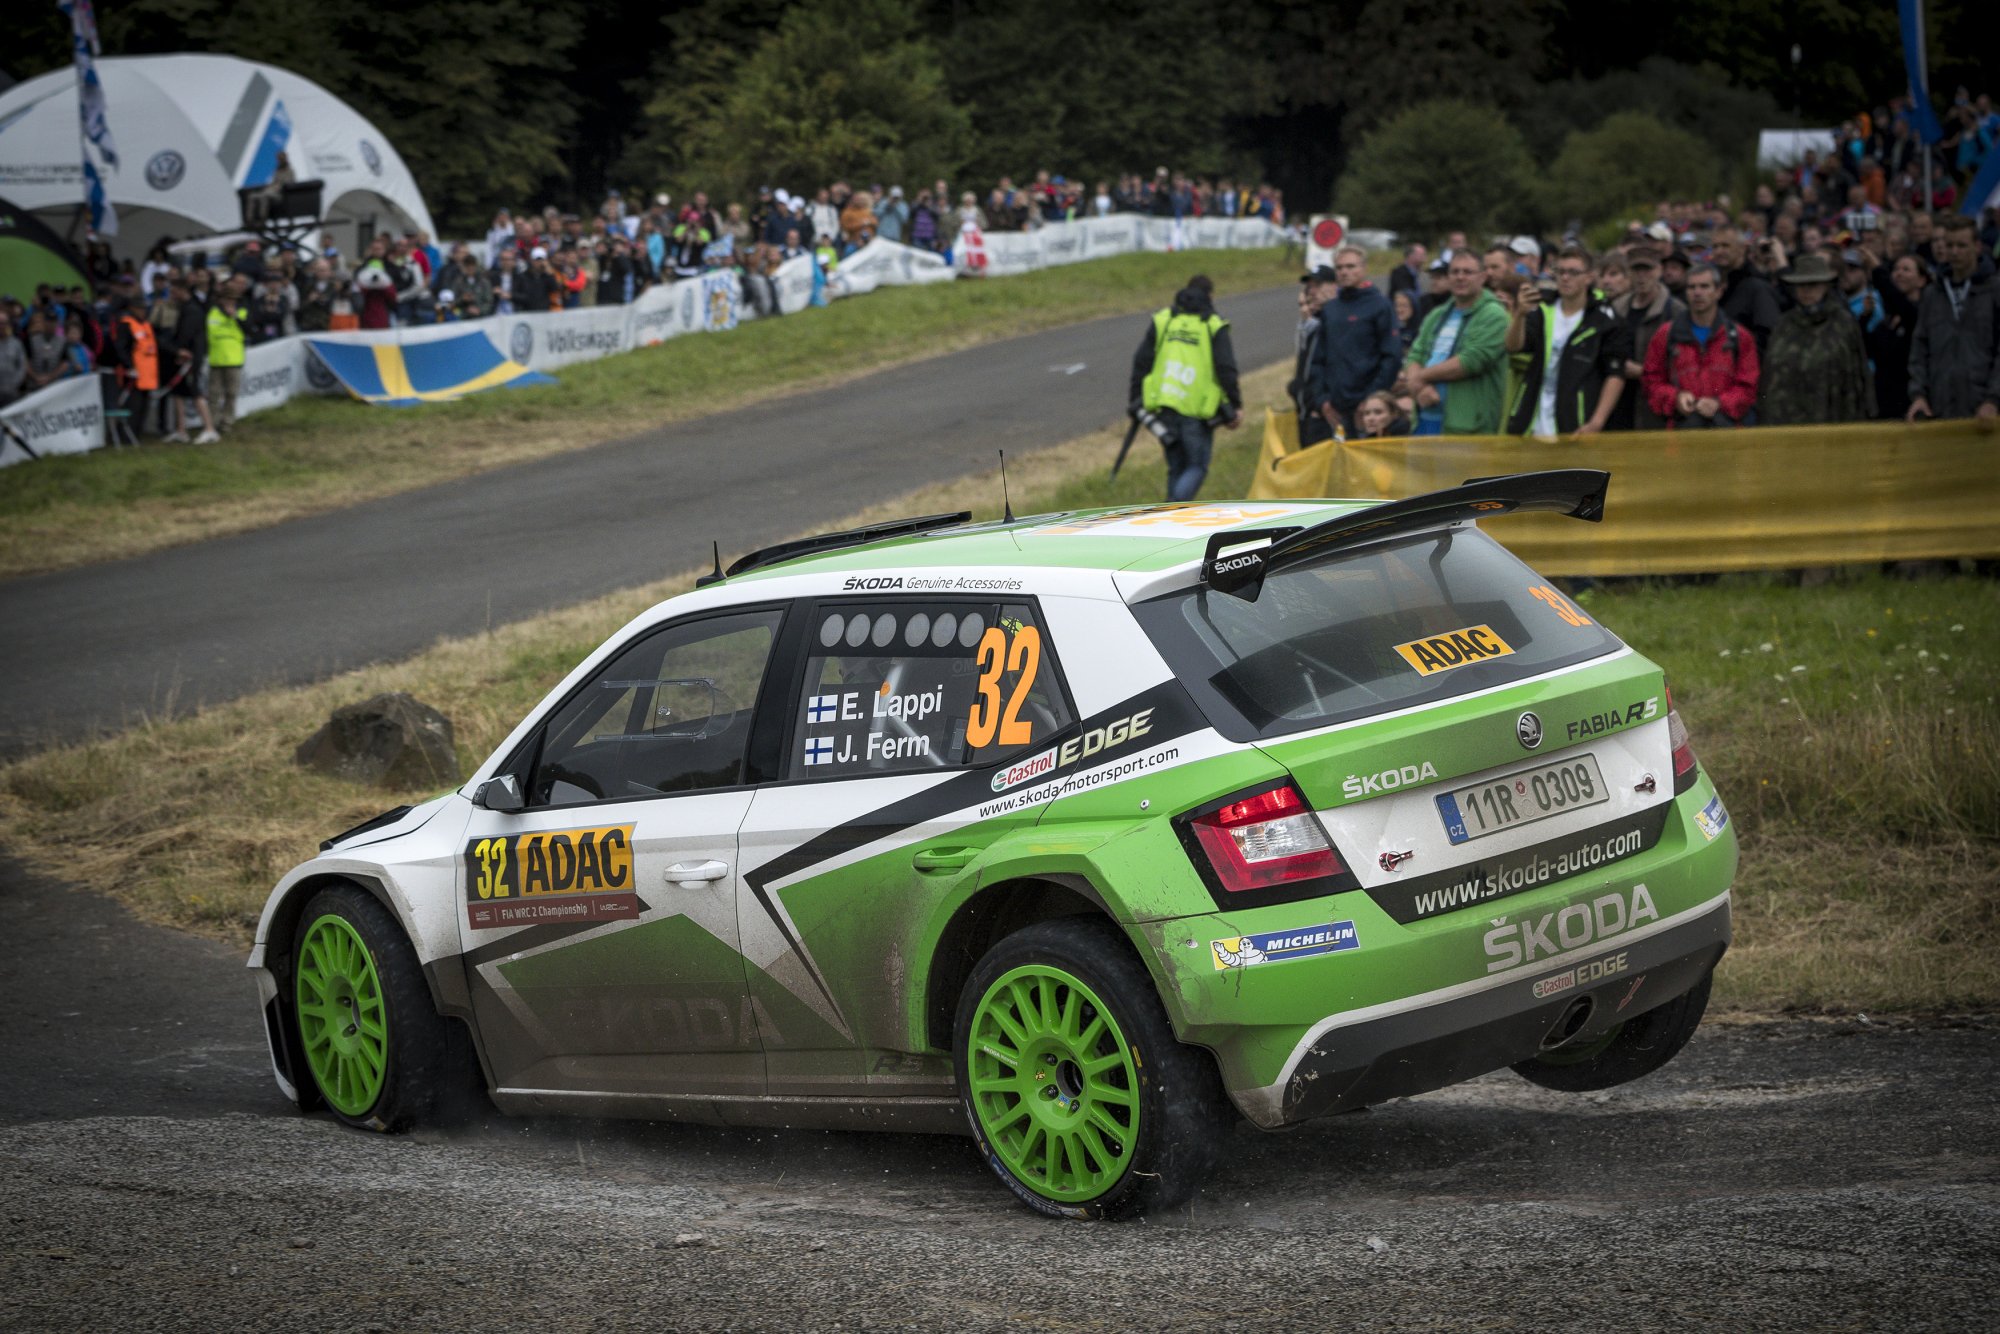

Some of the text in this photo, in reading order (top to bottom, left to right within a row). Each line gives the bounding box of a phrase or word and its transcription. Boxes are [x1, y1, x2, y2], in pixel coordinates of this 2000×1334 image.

[842, 577, 1023, 591] ŠKODA Genuine Accessories
[1214, 553, 1263, 574] ŠKODA
[1528, 585, 1593, 627] 32
[1410, 629, 1501, 671] ADAC
[841, 685, 943, 722] E. Lappi
[966, 626, 1041, 748] 32
[1566, 696, 1658, 741] FABIA R5
[837, 732, 930, 763] J. Ferm
[1008, 707, 1155, 785] Castrol EDGE
[980, 748, 1179, 818] www.skoda-motorsport.com
[1342, 761, 1438, 799] ŠKODA
[1466, 763, 1595, 829] 11R 0309
[1450, 825, 1465, 837] CZ
[474, 829, 628, 899] 32 ADAC
[1415, 827, 1641, 915] www.skoda-auto.com
[502, 904, 588, 920] FIA WRC 2 Championship
[1483, 882, 1659, 973] ŠKODA
[1267, 928, 1353, 951] MICHELIN
[1543, 952, 1629, 995] Castrol EDGE
